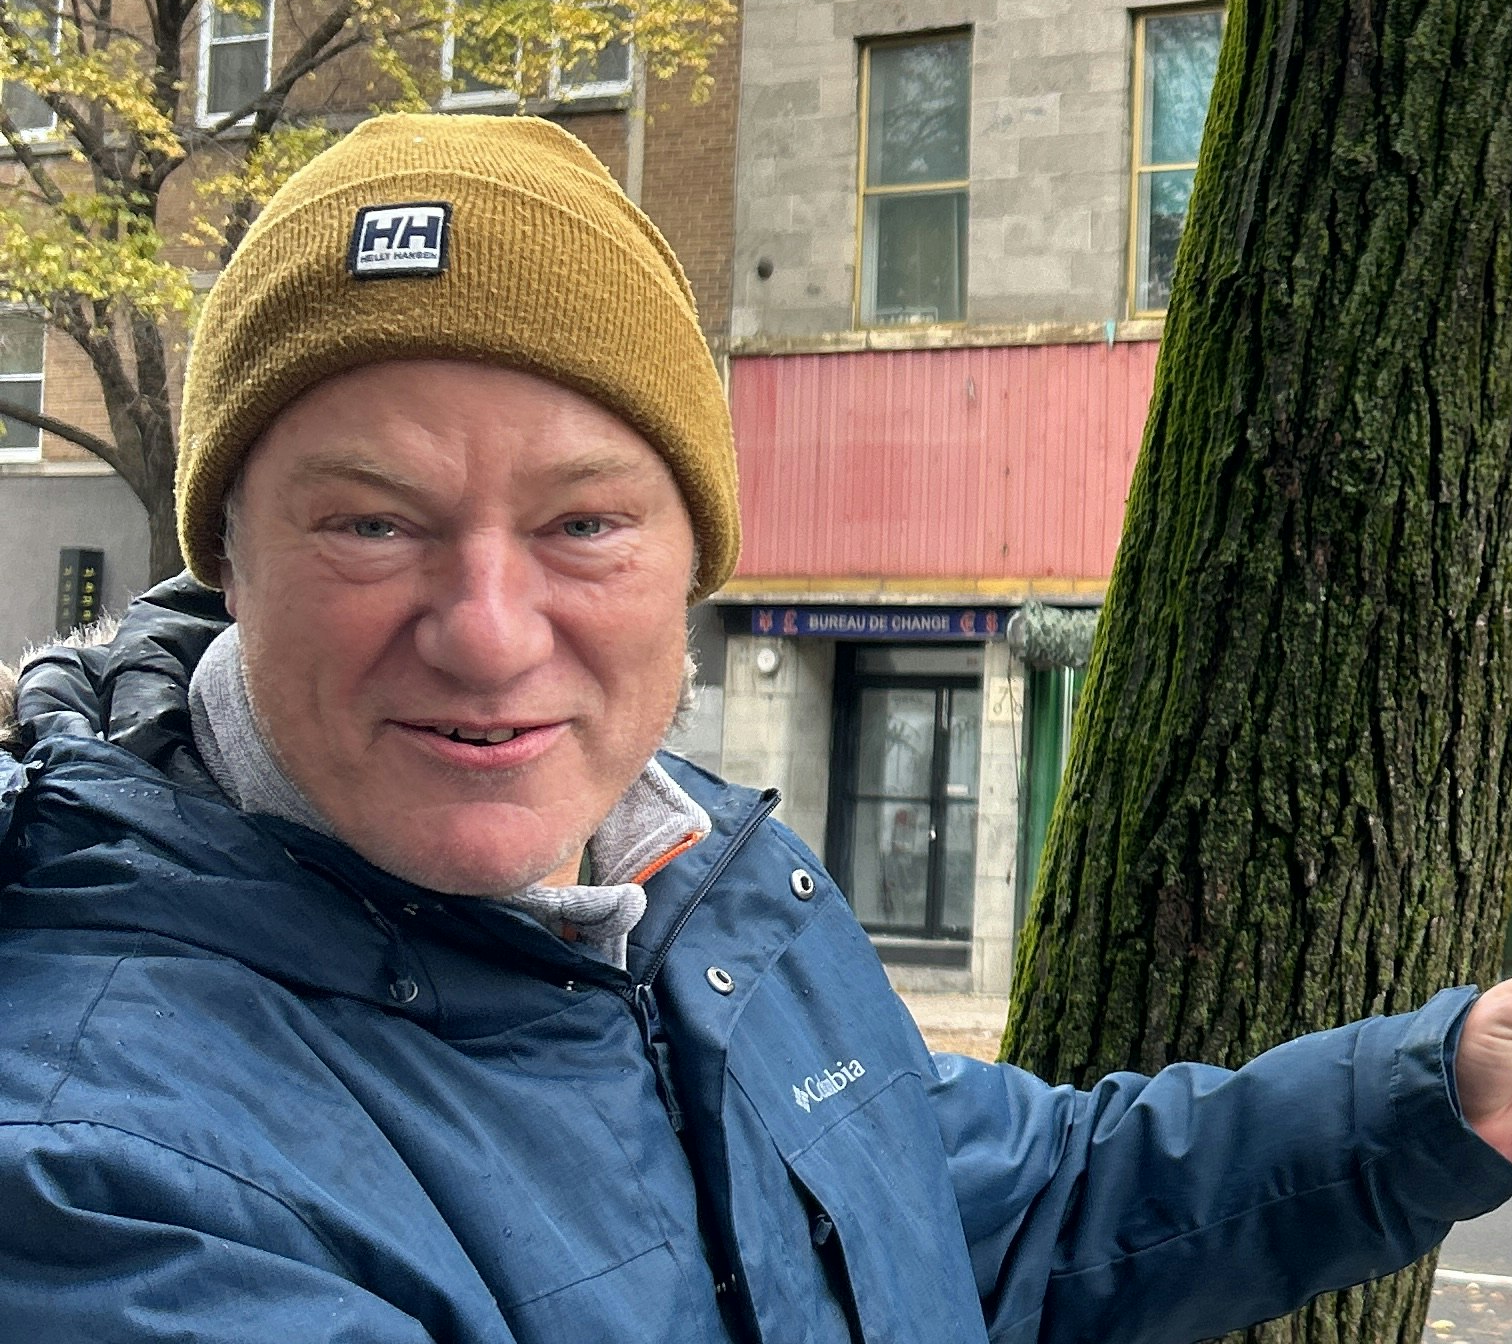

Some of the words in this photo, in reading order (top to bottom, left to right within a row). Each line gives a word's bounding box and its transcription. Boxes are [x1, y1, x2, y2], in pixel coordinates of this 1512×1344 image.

[361, 215, 441, 252] HH
[809, 613, 865, 632] BUREAU
[869, 614, 887, 632] DE
[891, 613, 949, 632] CHANGE
